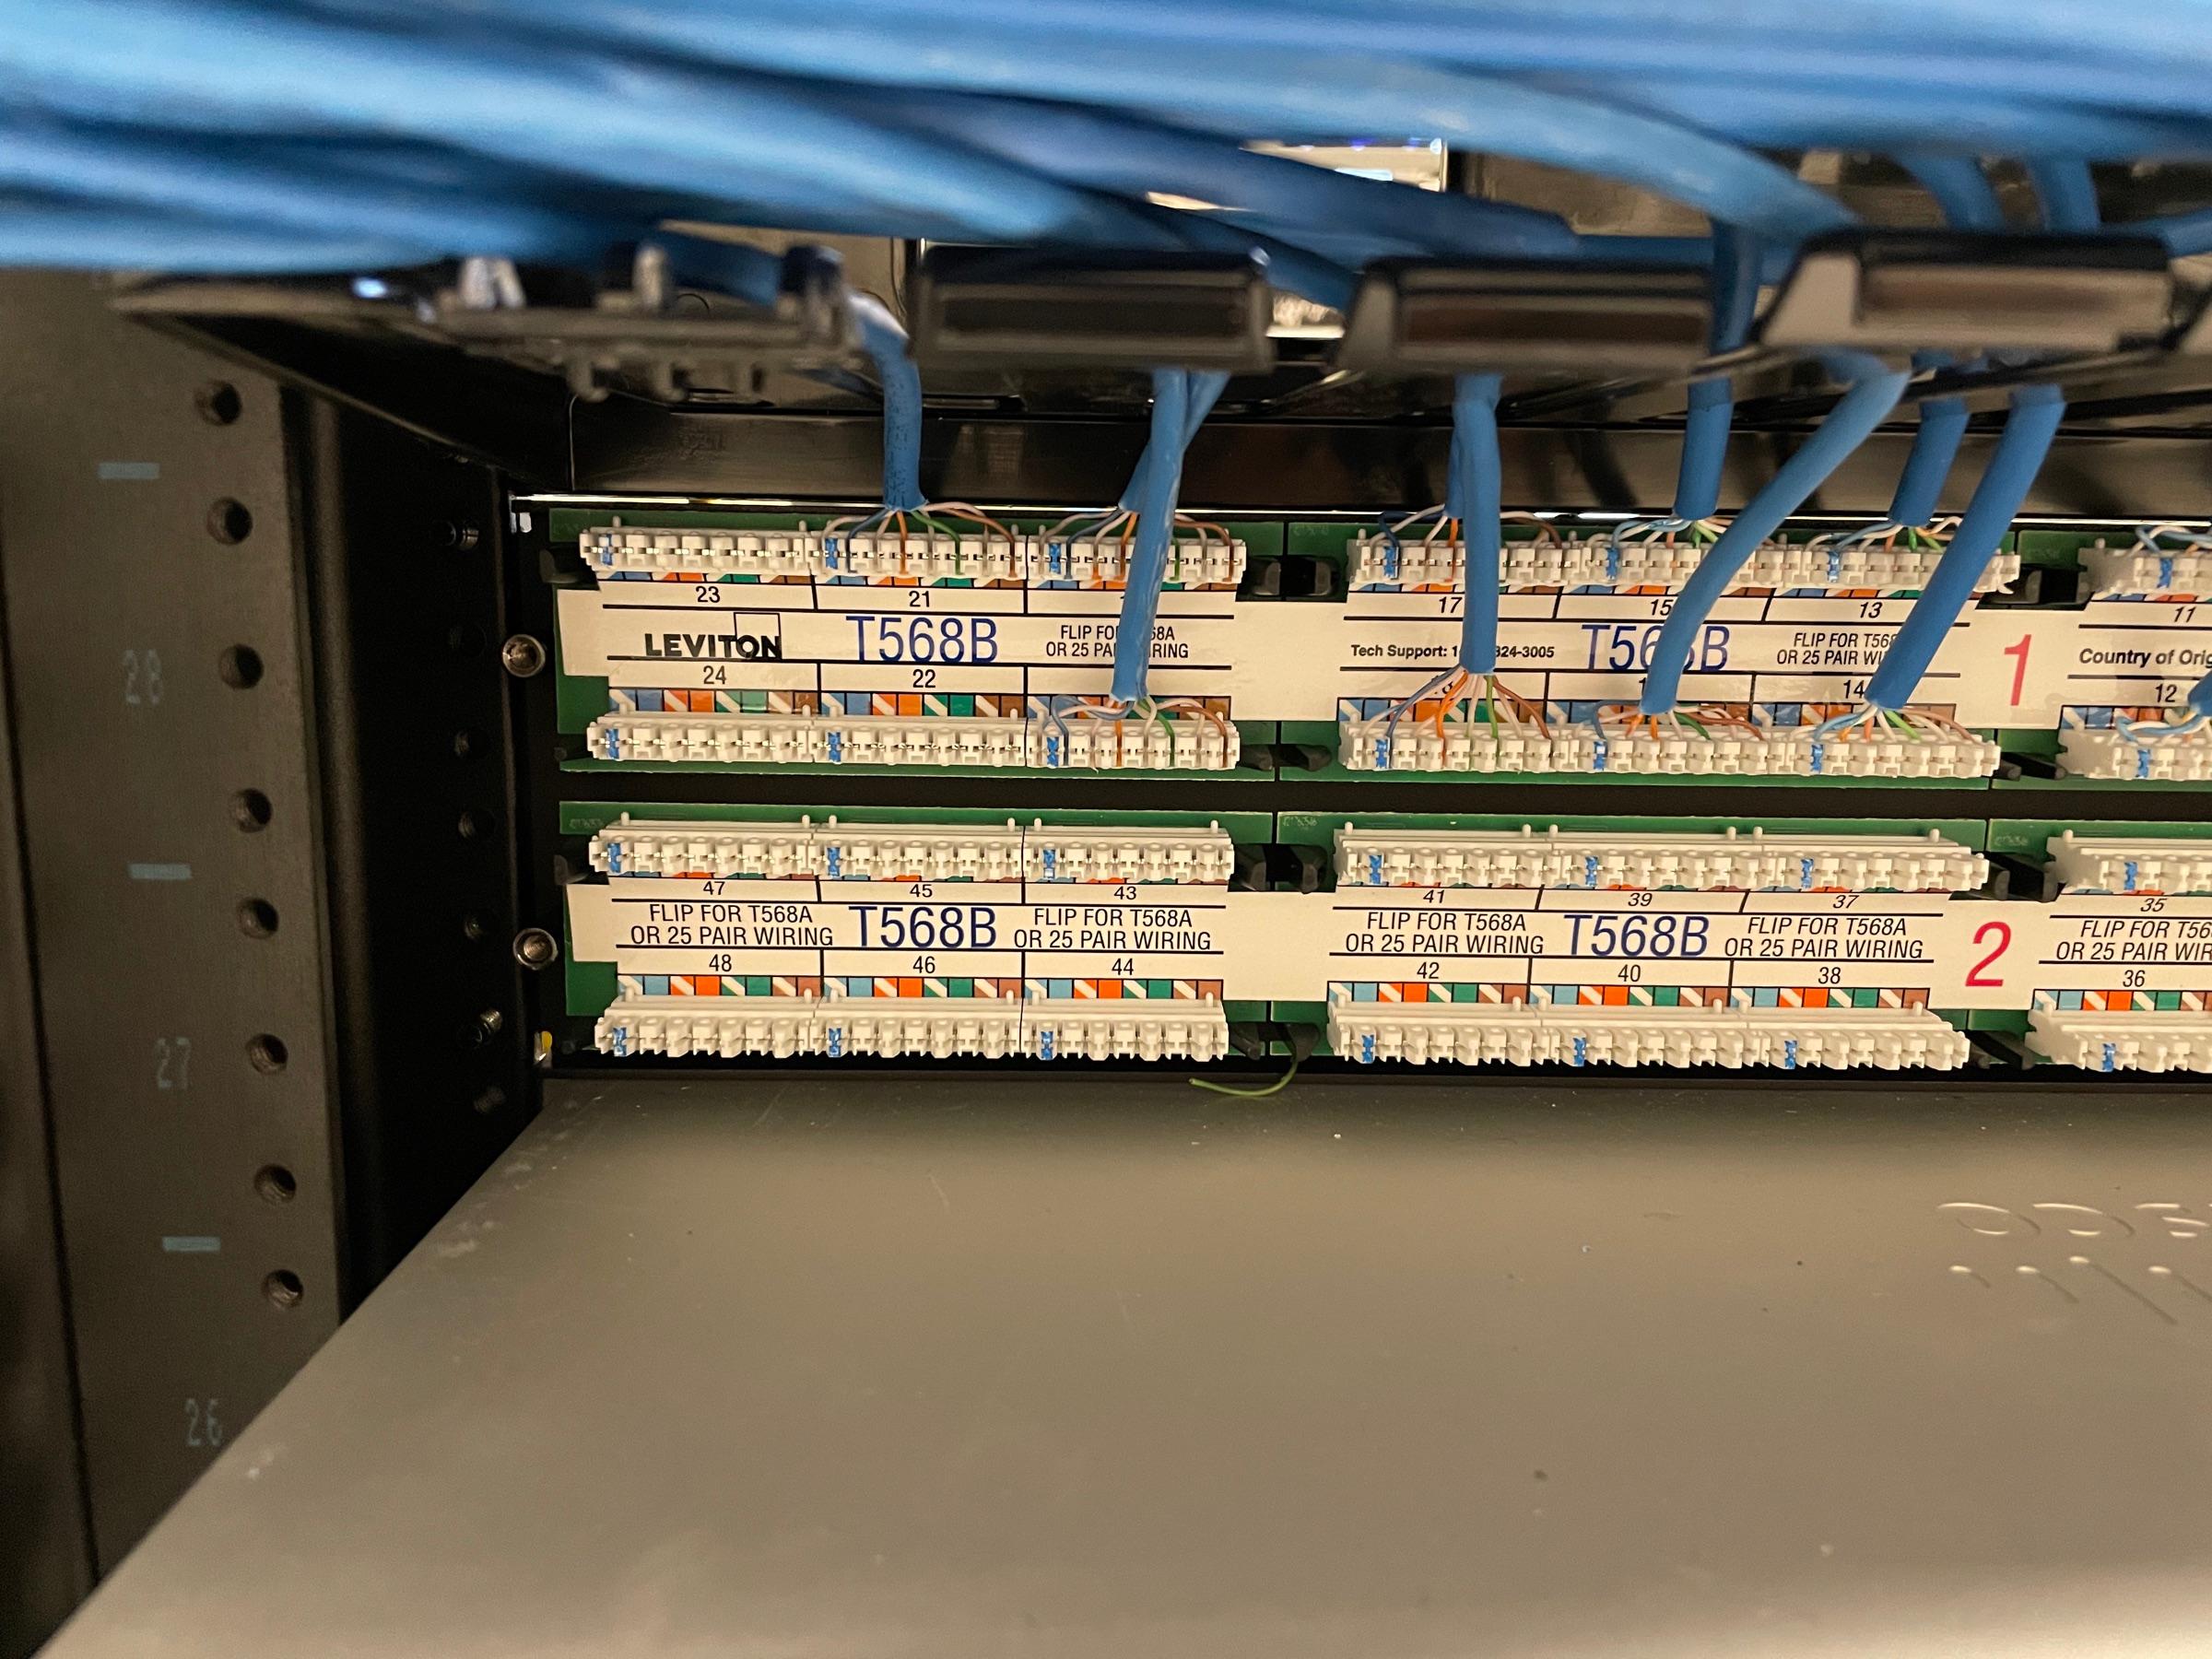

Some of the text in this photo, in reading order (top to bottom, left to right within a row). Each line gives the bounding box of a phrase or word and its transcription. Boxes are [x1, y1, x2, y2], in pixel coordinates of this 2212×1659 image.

[696, 586, 720, 603] 23
[909, 591, 929, 607] 21
[1440, 596, 1462, 613] 17
[1651, 599, 1674, 616] 15
[1861, 602, 1882, 618] 13
[2174, 606, 2195, 622] 11
[846, 617, 998, 663] T568B
[1061, 625, 1091, 639] FLIP
[1097, 626, 1118, 640] FO
[1794, 633, 1825, 647] FLIP
[1830, 633, 1858, 647] FOR
[645, 633, 782, 659] LEVITON
[1046, 641, 1066, 656] OR
[1072, 642, 1088, 656] 25
[1149, 643, 1188, 658] RING
[1351, 644, 1382, 656] Tech
[1388, 645, 1447, 660] Support:
[1777, 650, 1797, 665] OR
[1802, 651, 1820, 665] 25
[1825, 650, 1858, 665] PAIR
[2080, 649, 2151, 668] Country
[2156, 650, 2174, 665] of
[123, 649, 164, 706] 28
[703, 665, 726, 684] 24
[913, 669, 935, 688] 22
[2004, 634, 2032, 706] 1
[1843, 679, 1865, 699] 14
[2156, 684, 2177, 702] 12
[703, 881, 724, 895] 47
[910, 884, 932, 898] 45
[1114, 887, 1136, 900] 43
[1423, 889, 1444, 903] 41
[1629, 893, 1653, 906] 39
[1833, 895, 1859, 908] 37
[2141, 899, 2167, 912] 35
[650, 904, 812, 923] FLIP FOR T568A
[1035, 908, 1192, 927] FLIP FOR T568A
[1368, 912, 1525, 931] FLIP FOR T568A
[848, 906, 996, 948] T568B
[1748, 917, 1906, 935] FLIP FOR T568A
[2081, 921, 2212, 938] FLIP FOR T56
[631, 926, 832, 946] OR 25 PAIR WIRING
[1015, 929, 1210, 949] OR 25 PAIR WIRING
[1347, 934, 1543, 954] OR 25 PAIR WIRING
[1563, 914, 1710, 957] T568B
[1725, 938, 1923, 959] OR 25 PAIR WIRING
[1965, 921, 2012, 987] 2
[2057, 942, 2084, 959] OR
[2091, 943, 2115, 959] 25
[2122, 943, 2168, 960] PAIR
[709, 954, 732, 971] 48
[913, 956, 935, 973] 46
[1112, 959, 1134, 975] 44
[1417, 962, 1439, 979] 42
[1618, 964, 1641, 982] 40
[1818, 967, 1841, 984] 38
[2123, 970, 2145, 987] 36
[154, 1037, 191, 1088] 27
[185, 1398, 222, 1446] 26
